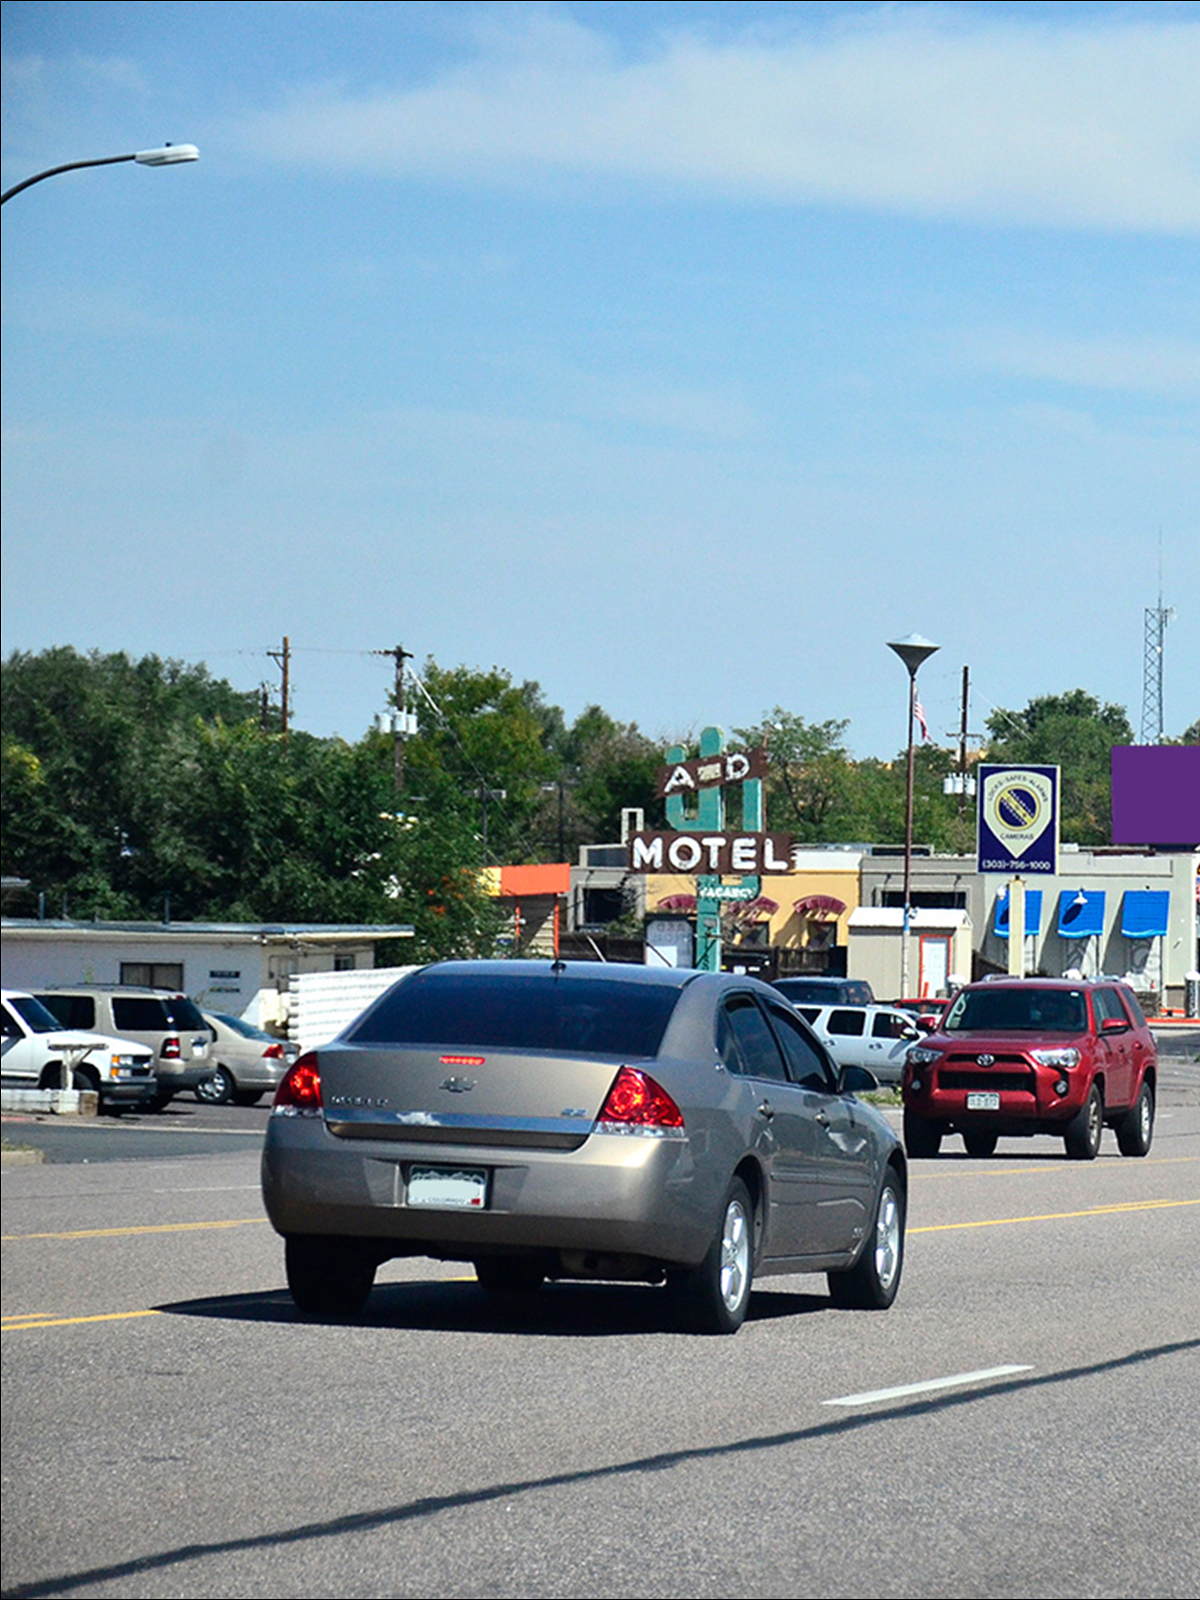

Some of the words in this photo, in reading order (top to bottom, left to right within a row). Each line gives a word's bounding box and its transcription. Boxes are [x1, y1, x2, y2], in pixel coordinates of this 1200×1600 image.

[664, 765, 695, 792] A
[725, 754, 750, 781] D
[632, 836, 789, 870] MOTEL
[1000, 832, 1035, 840] CAMERAS
